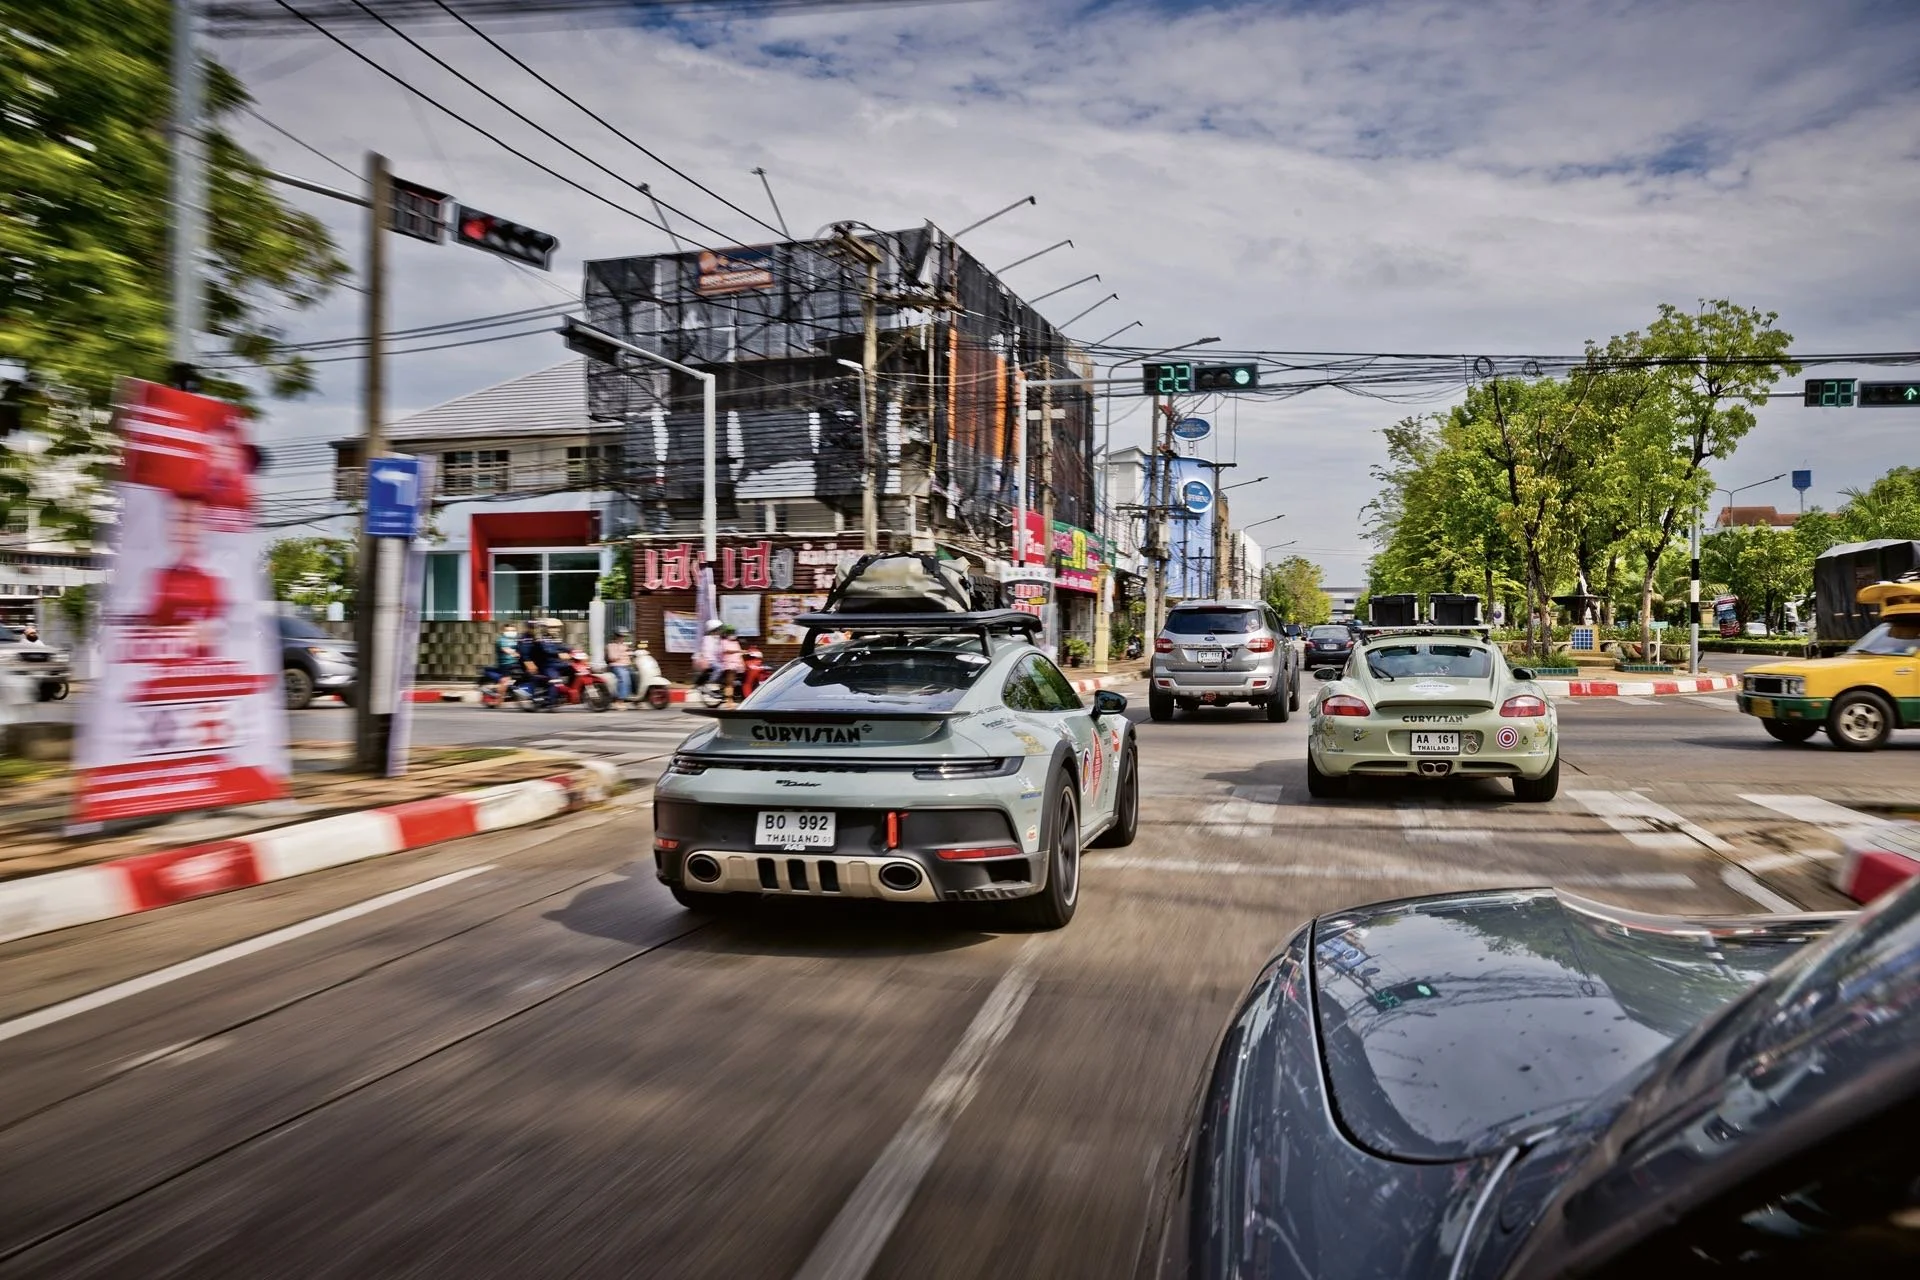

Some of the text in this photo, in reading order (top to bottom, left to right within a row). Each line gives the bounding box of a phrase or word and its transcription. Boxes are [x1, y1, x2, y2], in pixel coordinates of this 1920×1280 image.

[1158, 365, 1190, 392] 22
[751, 724, 861, 744] CURVISTAN
[1416, 734, 1454, 744] AA 161
[798, 815, 829, 831] 992
[766, 833, 819, 843] THAILAND
